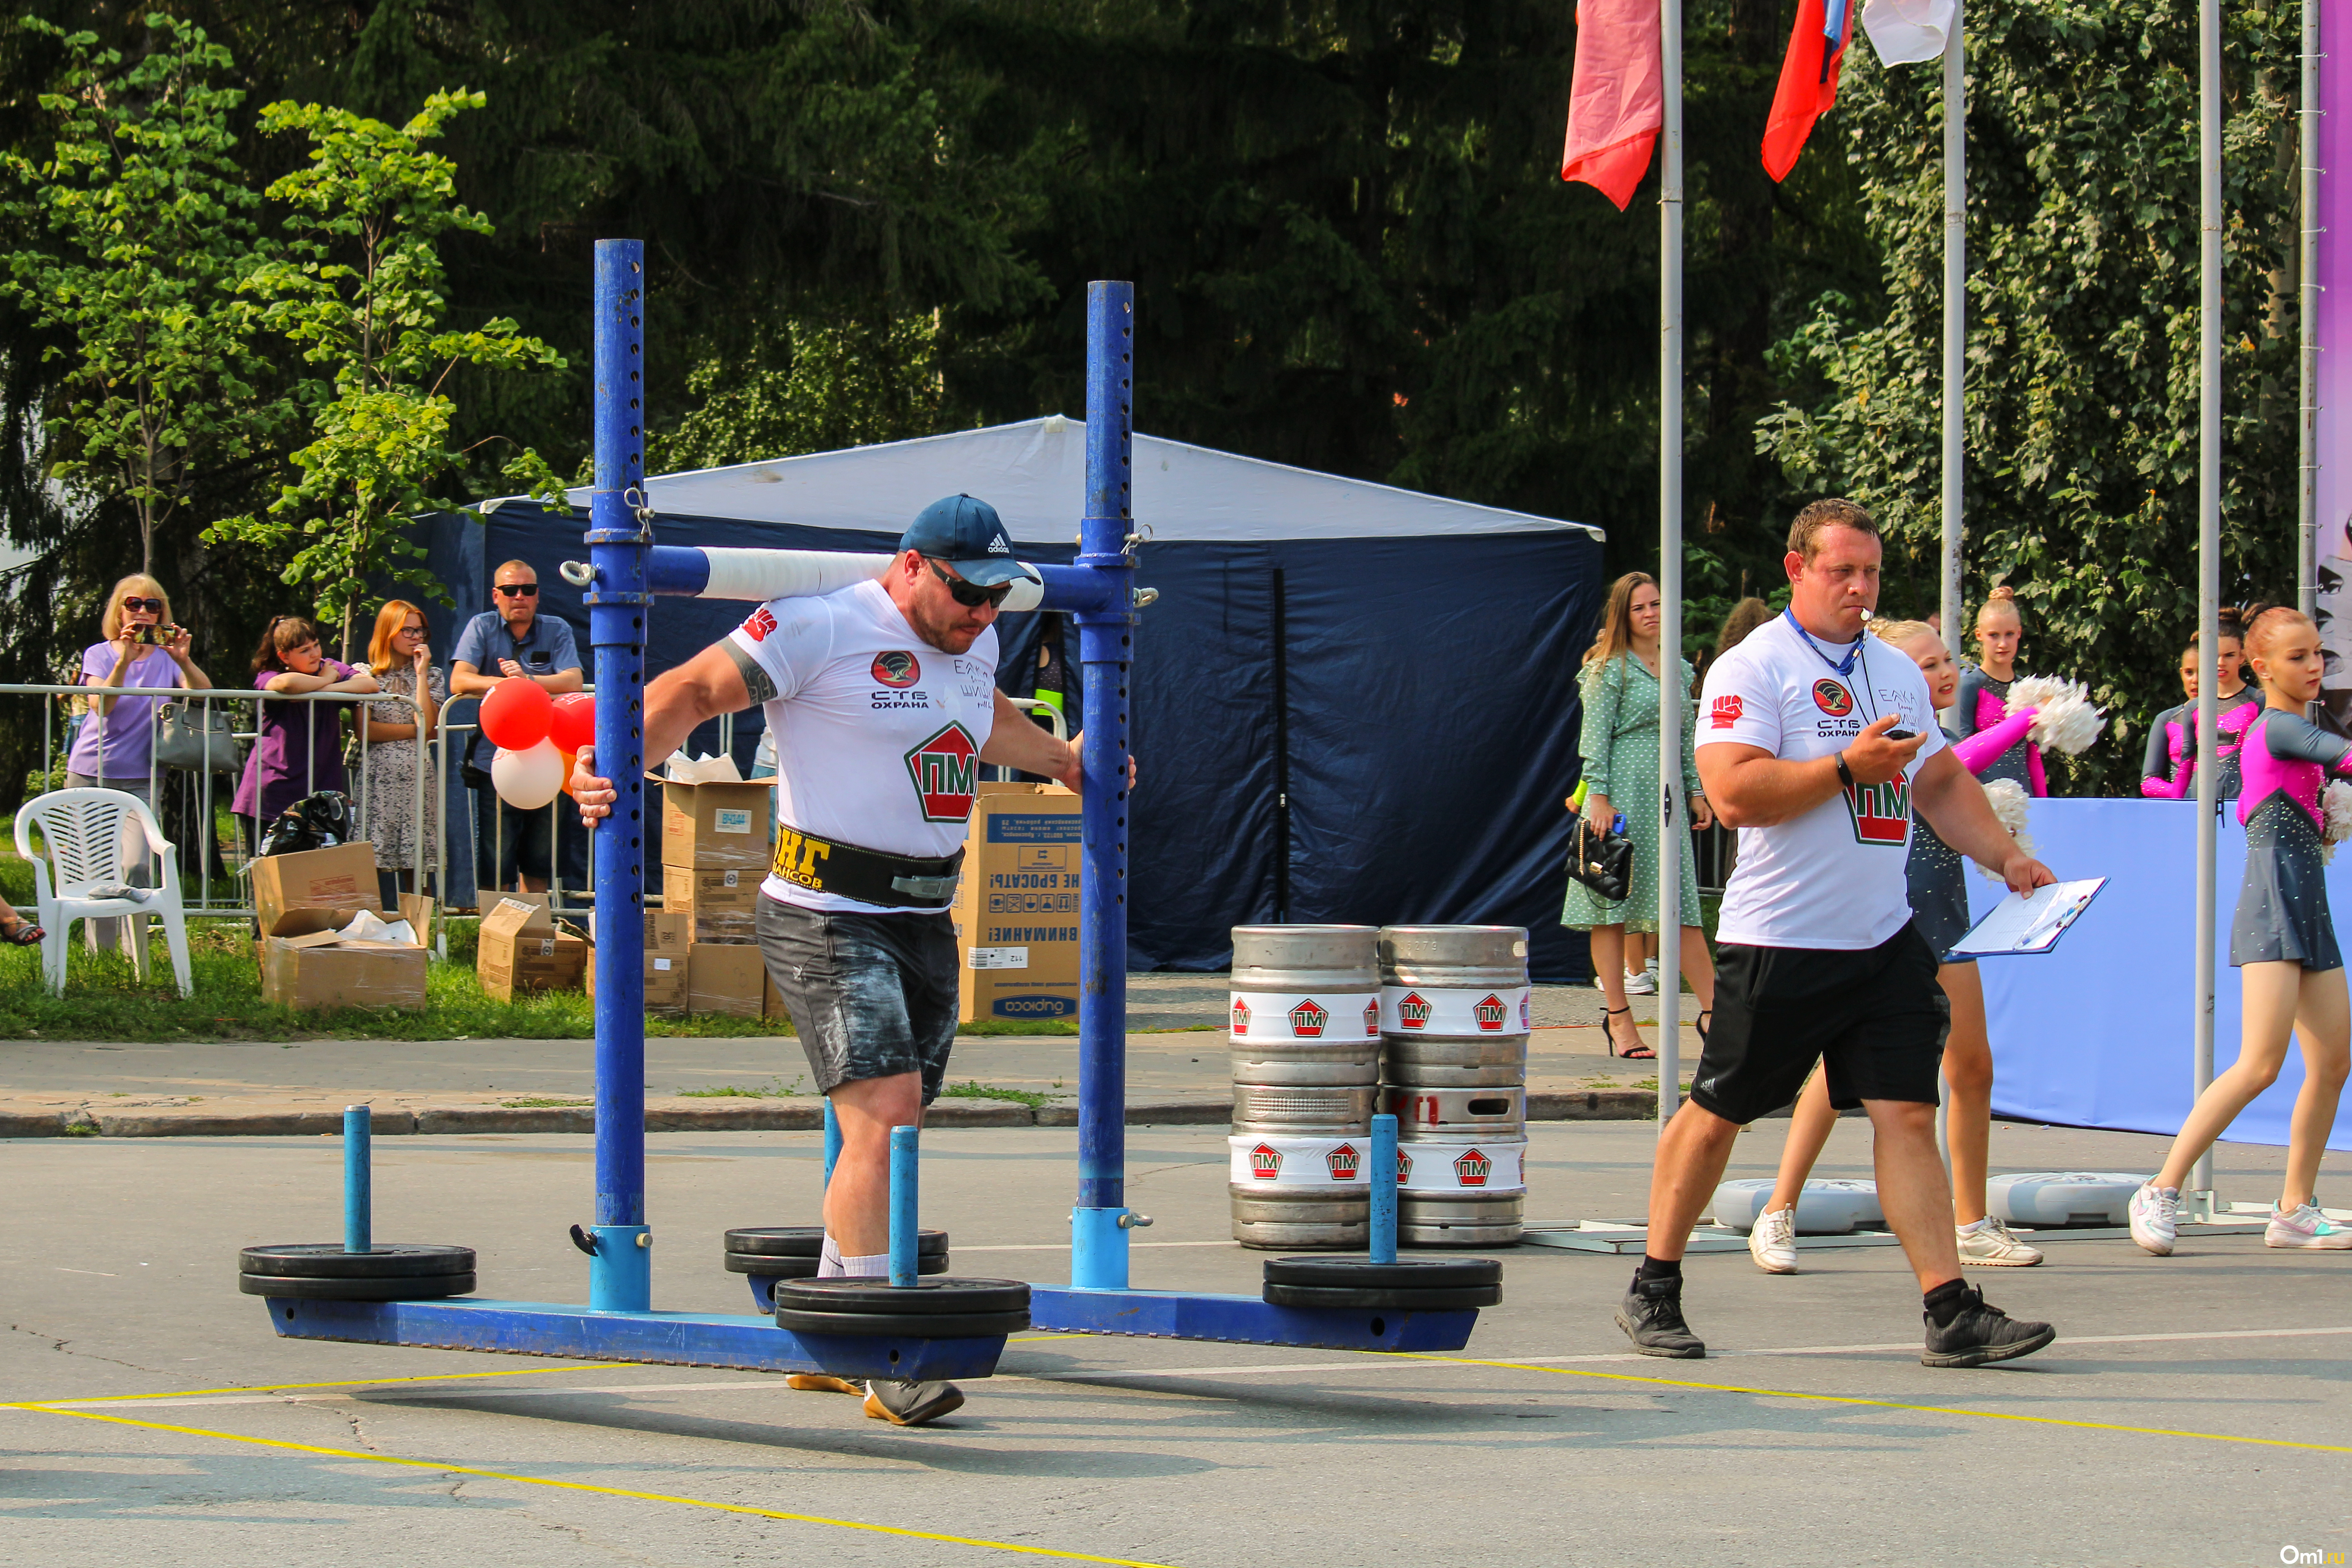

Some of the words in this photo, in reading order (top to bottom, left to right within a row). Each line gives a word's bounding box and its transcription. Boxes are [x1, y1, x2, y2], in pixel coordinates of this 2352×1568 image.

[988, 545, 1009, 554] adidas
[871, 691, 928, 700] СТБ
[1817, 720, 1860, 729] СТБ
[919, 751, 975, 796] ПМ
[1854, 780, 1909, 820] ПМ
[989, 874, 1057, 888] БРОСАТЬ!
[1063, 874, 1080, 888] НЕ
[988, 927, 1078, 942] ВНИМАНИЕ!
[1293, 1010, 1324, 1027] ПМ
[1401, 1003, 1426, 1020] ПМ
[1479, 1005, 1503, 1022] ПМ
[1253, 1153, 1278, 1170] ПМ
[1331, 1154, 1357, 1170] ПМ
[1397, 1158, 1409, 1174] М
[1459, 1160, 1487, 1176] ПМ
